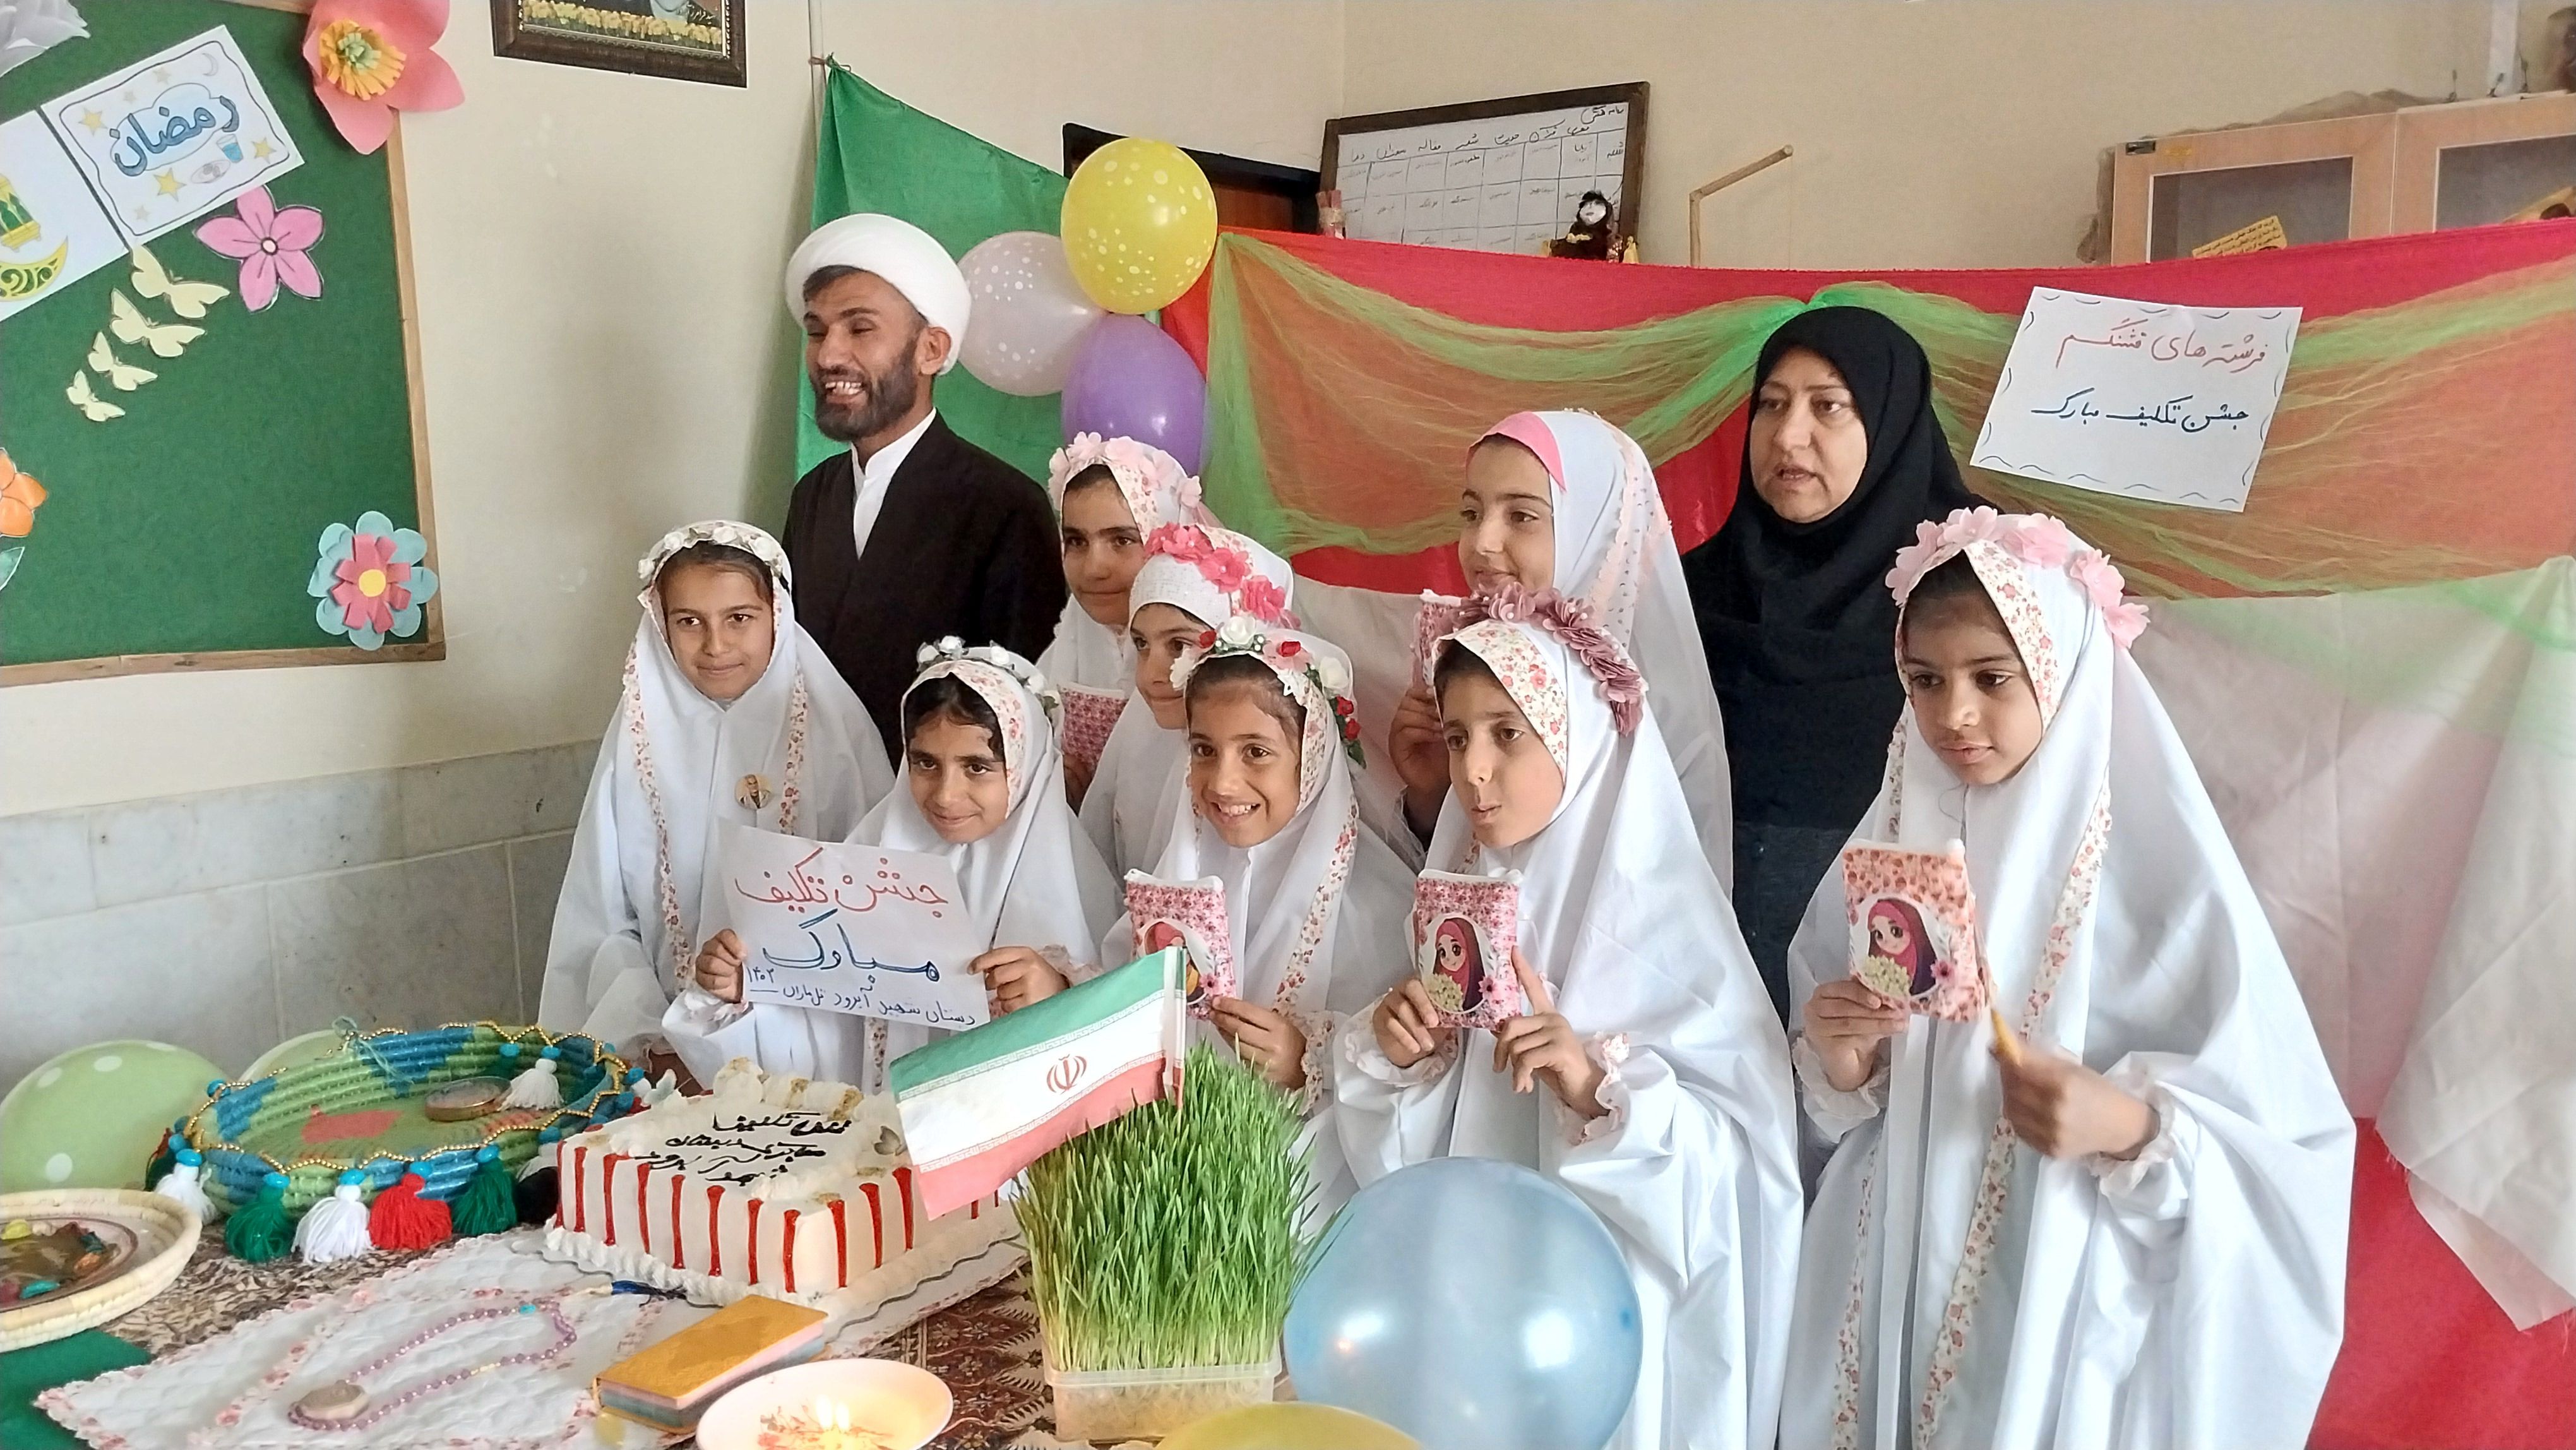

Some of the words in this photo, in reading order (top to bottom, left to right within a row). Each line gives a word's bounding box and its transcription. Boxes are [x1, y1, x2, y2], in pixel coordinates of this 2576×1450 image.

[109, 96, 240, 176] رمضان
[2055, 317, 2147, 369] قشنگم
[2151, 329, 2206, 361] های
[2202, 333, 2269, 374] فرشته
[2030, 387, 2099, 424] مبارک
[2106, 395, 2194, 427] تکلیف
[2181, 404, 2250, 433] جشن
[734, 846, 830, 914] تکلیف
[834, 857, 949, 919] جشن
[761, 908, 941, 984] مبارک
